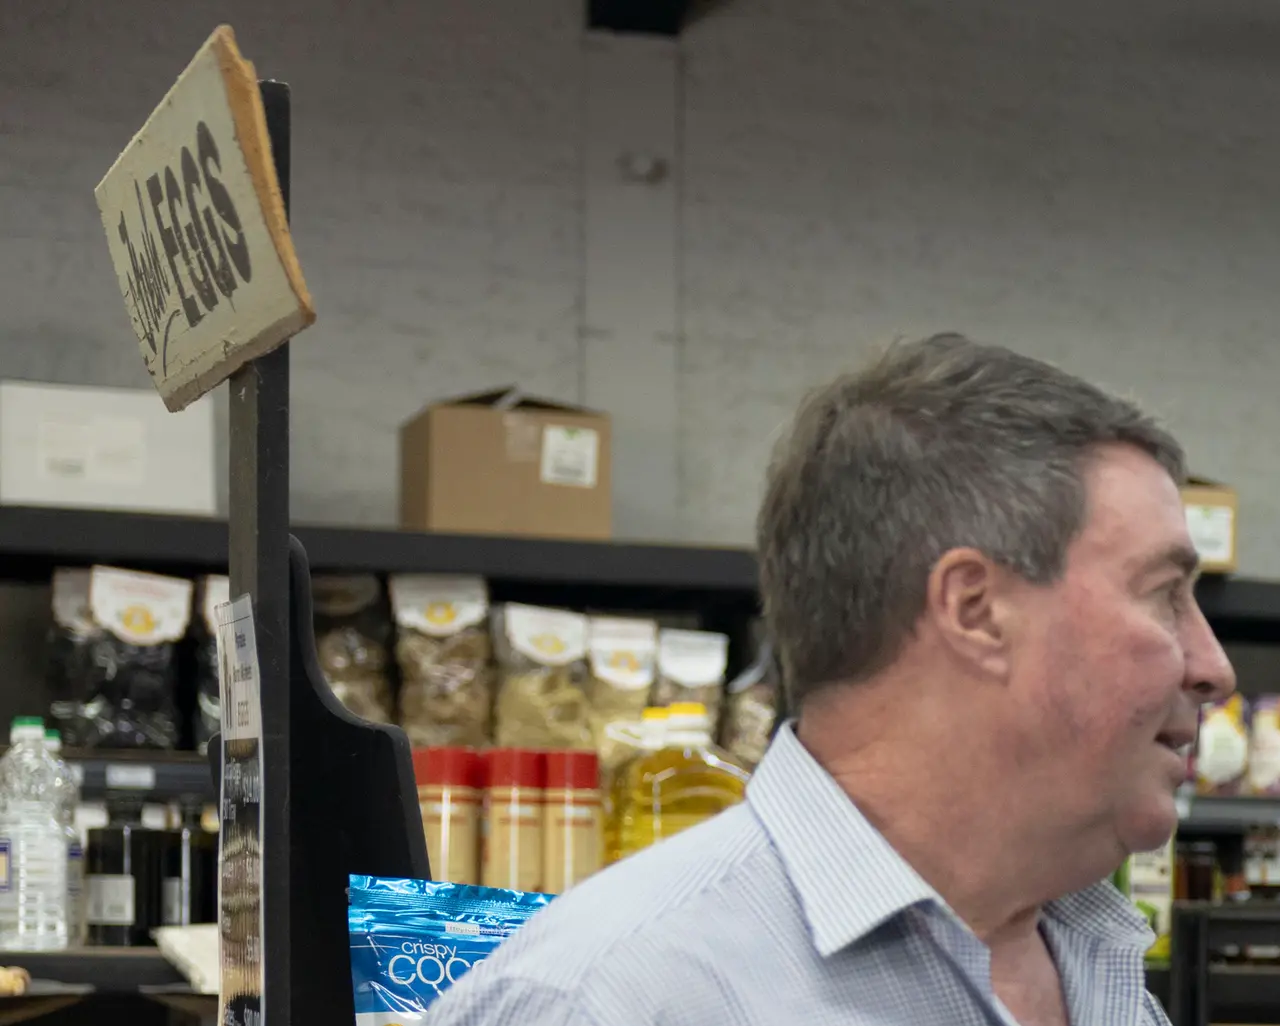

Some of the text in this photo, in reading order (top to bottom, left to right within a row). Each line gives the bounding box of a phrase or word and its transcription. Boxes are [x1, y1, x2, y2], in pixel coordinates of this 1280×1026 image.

[146, 121, 252, 328] EGGS
[401, 940, 457, 959] crispy
[388, 954, 487, 986] COC
